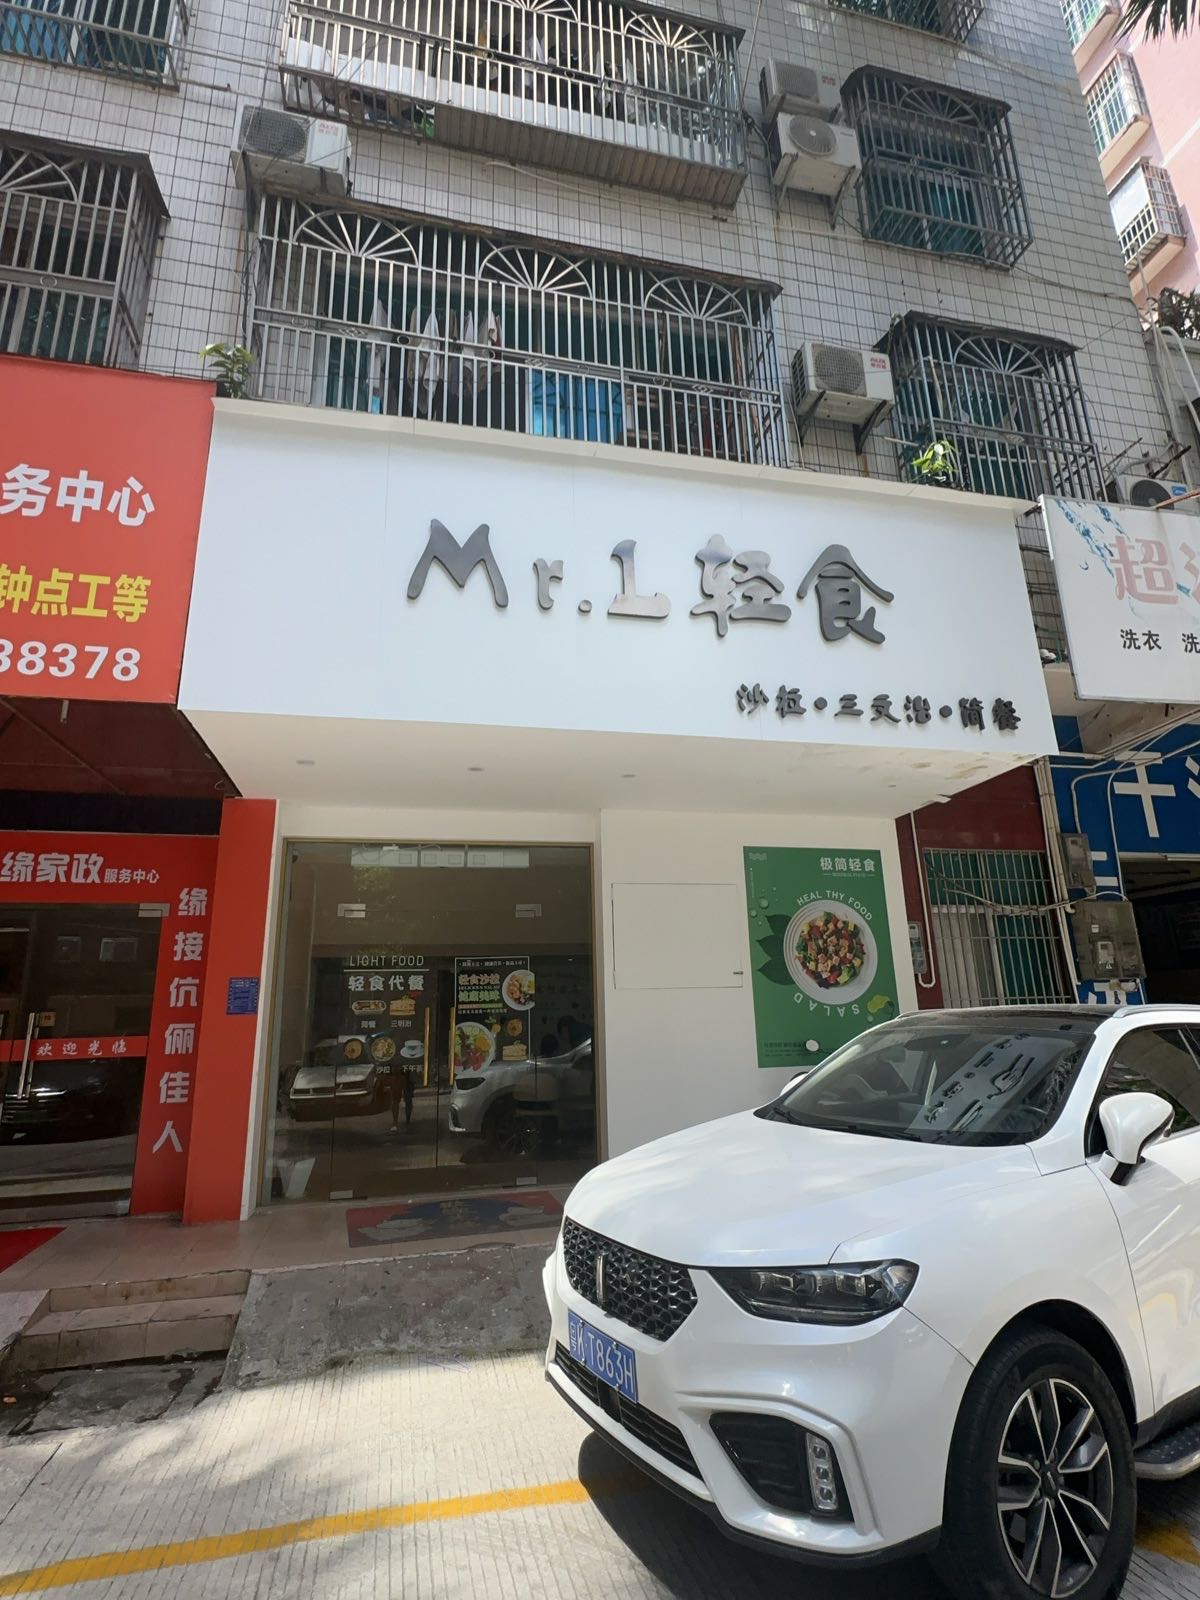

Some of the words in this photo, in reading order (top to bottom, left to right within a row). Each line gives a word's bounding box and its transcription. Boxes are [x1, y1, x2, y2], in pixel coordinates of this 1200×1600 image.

[0, 464, 155, 527] 务中心
[0, 563, 151, 623] 钟点工等
[1120, 628, 1162, 651] 洗衣
[819, 857, 876, 873] 极简轻食
[848, 897, 873, 921] FOOD
[349, 955, 386, 967] LIGHT
[391, 955, 424, 966] FOOD
[347, 975, 425, 992] 轻食代餐
[793, 992, 860, 1017] SALAD
[152, 887, 208, 1154] 缘接伉俪佳人
[36, 1038, 127, 1057] 欢迎光临
